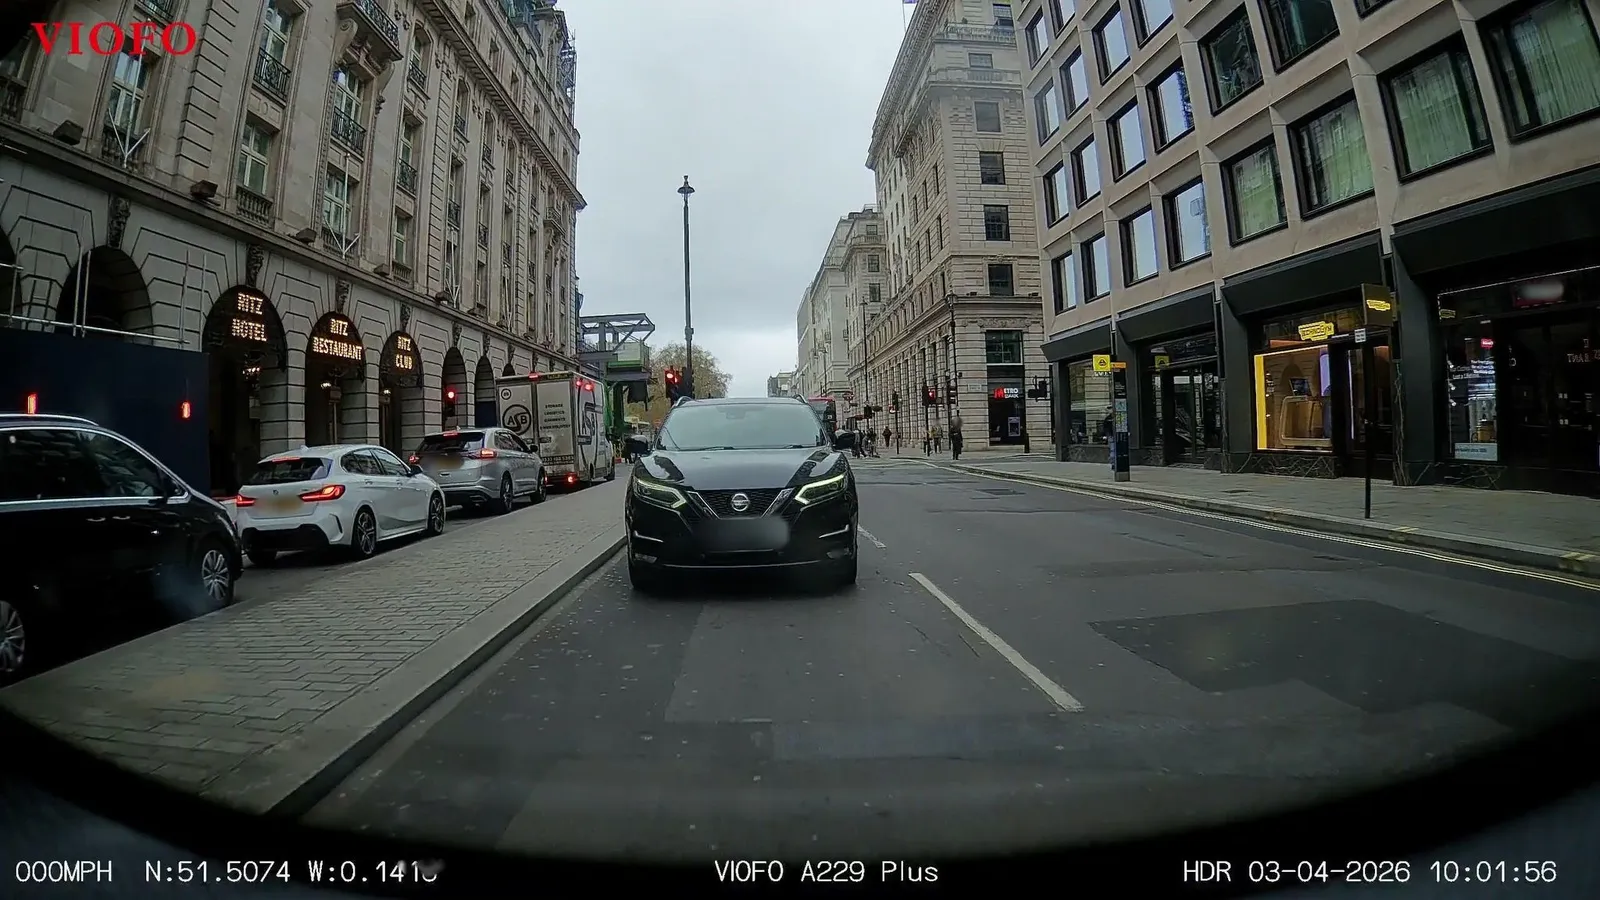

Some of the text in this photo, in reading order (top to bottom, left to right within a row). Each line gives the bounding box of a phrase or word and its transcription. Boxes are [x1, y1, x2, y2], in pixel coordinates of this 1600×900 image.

[238, 292, 263, 314] RITZ
[232, 318, 267, 341] HOTEL
[330, 318, 348, 336] RITZ
[312, 336, 362, 360] RESTAURANT
[397, 335, 411, 351] RITZ
[395, 354, 412, 370] CLUB
